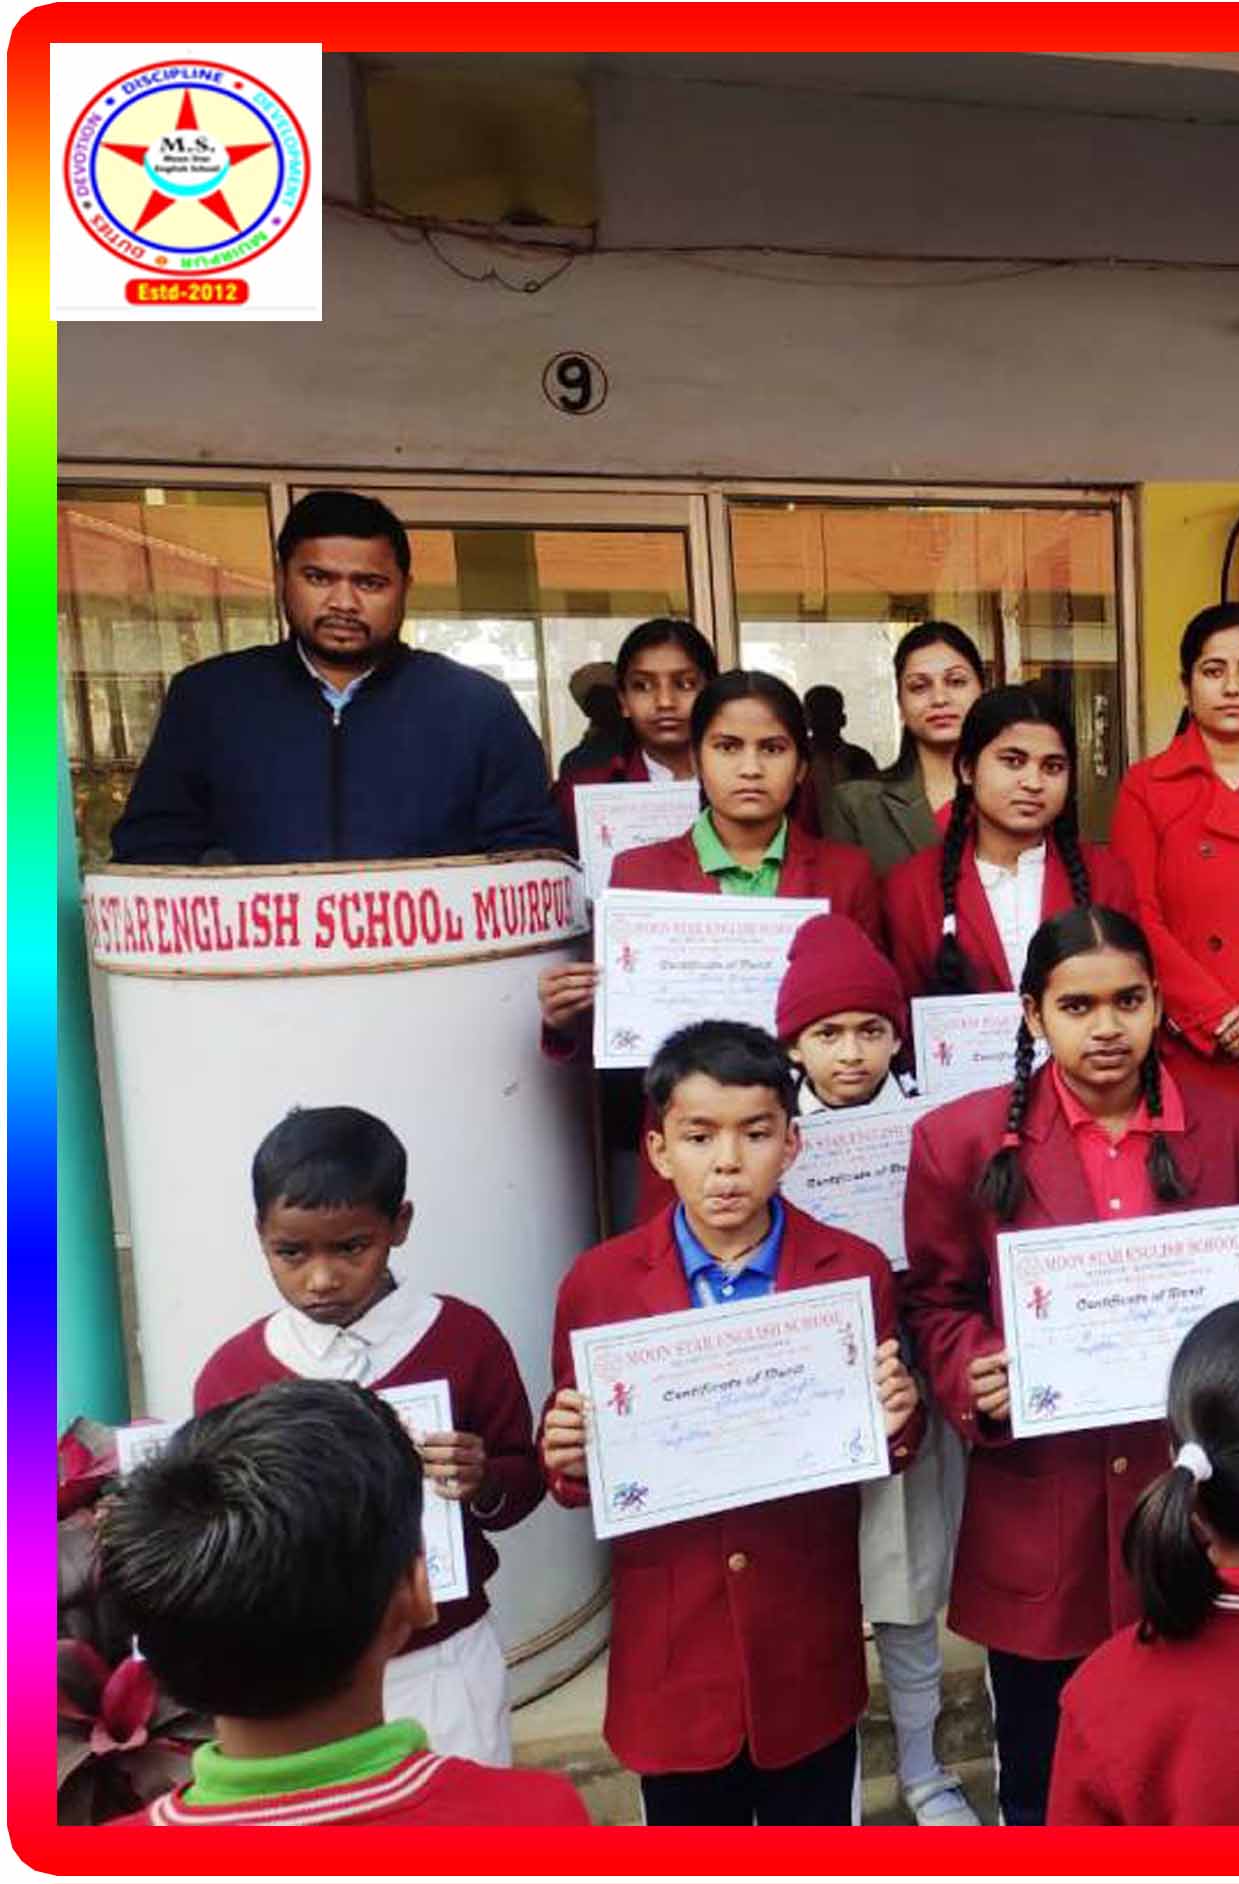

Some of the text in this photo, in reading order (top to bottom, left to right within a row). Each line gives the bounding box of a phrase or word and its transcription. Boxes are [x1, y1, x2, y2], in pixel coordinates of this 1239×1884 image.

[557, 356, 592, 410] 9
[315, 887, 463, 948] SCHOOL
[662, 1379, 742, 1403] Certificate
